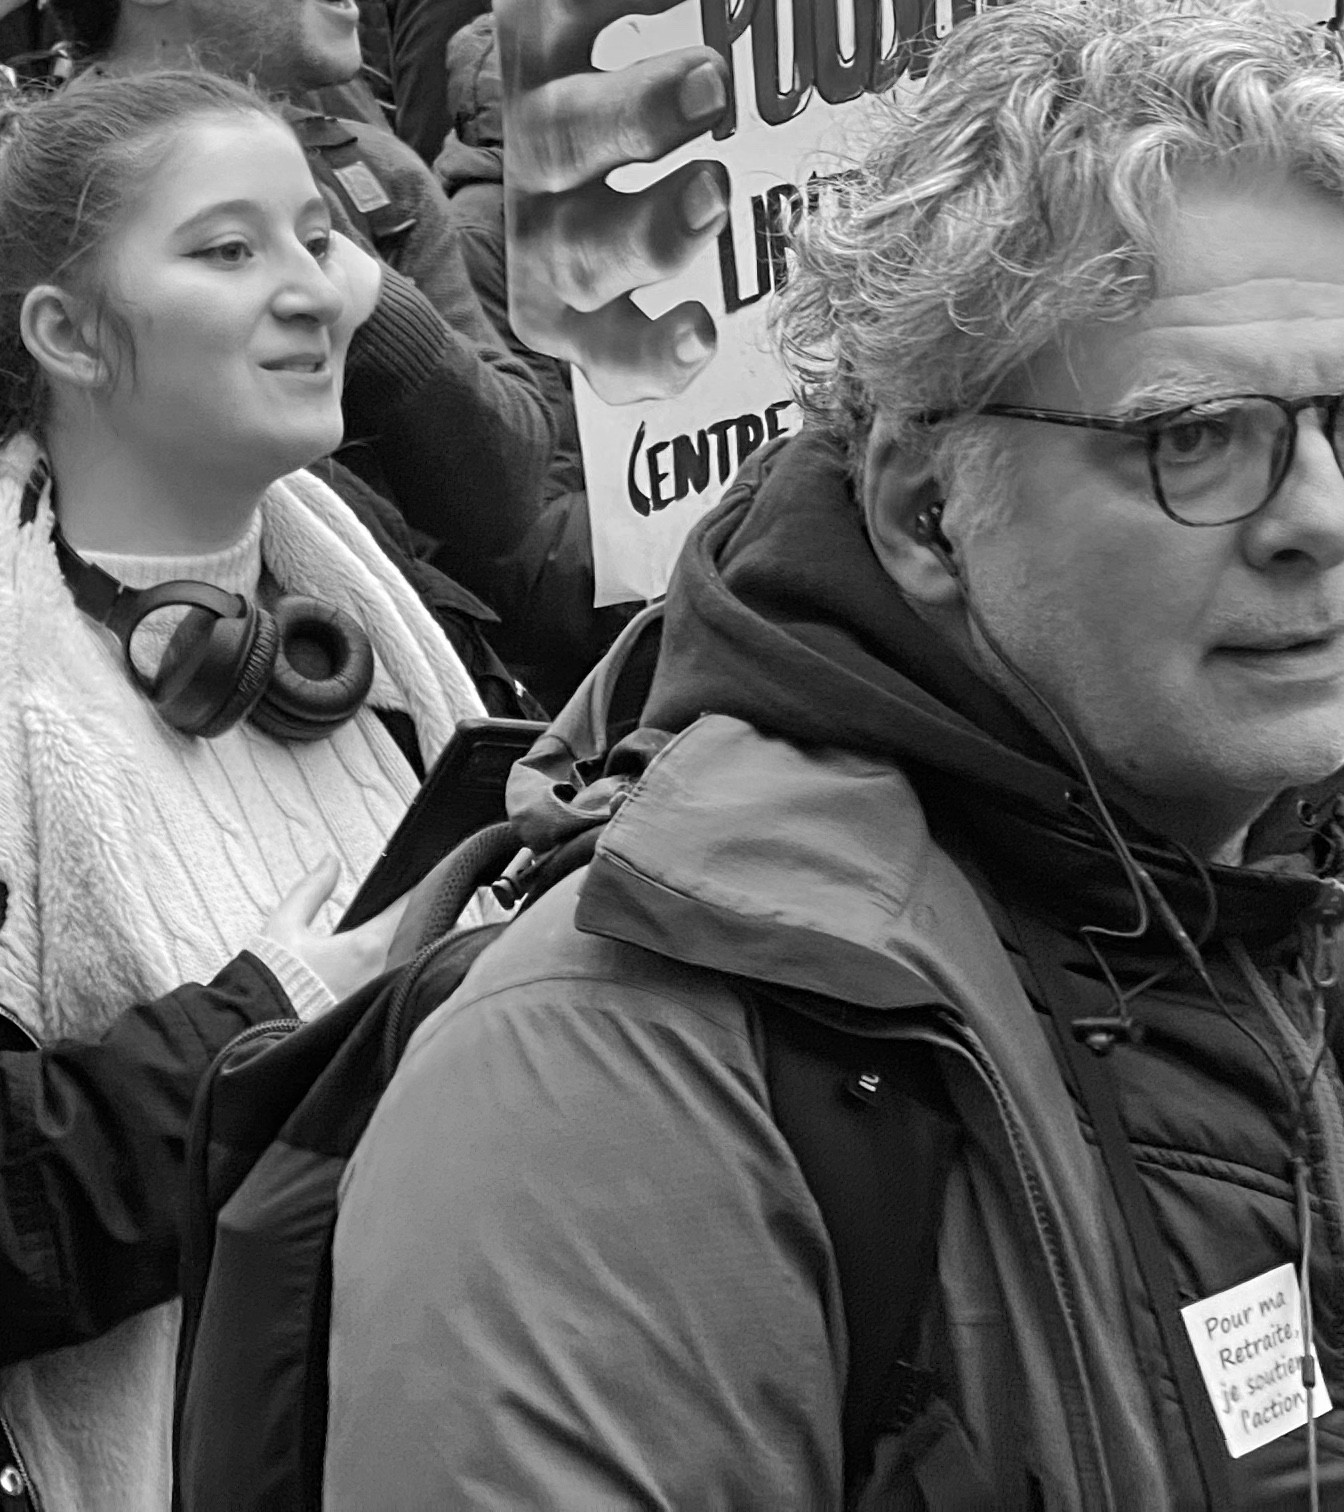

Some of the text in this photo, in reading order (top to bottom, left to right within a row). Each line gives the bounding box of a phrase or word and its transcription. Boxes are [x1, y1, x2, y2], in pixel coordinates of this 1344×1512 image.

[1205, 1290, 1287, 1340] Pour ma
[1220, 1378, 1241, 1414] je
